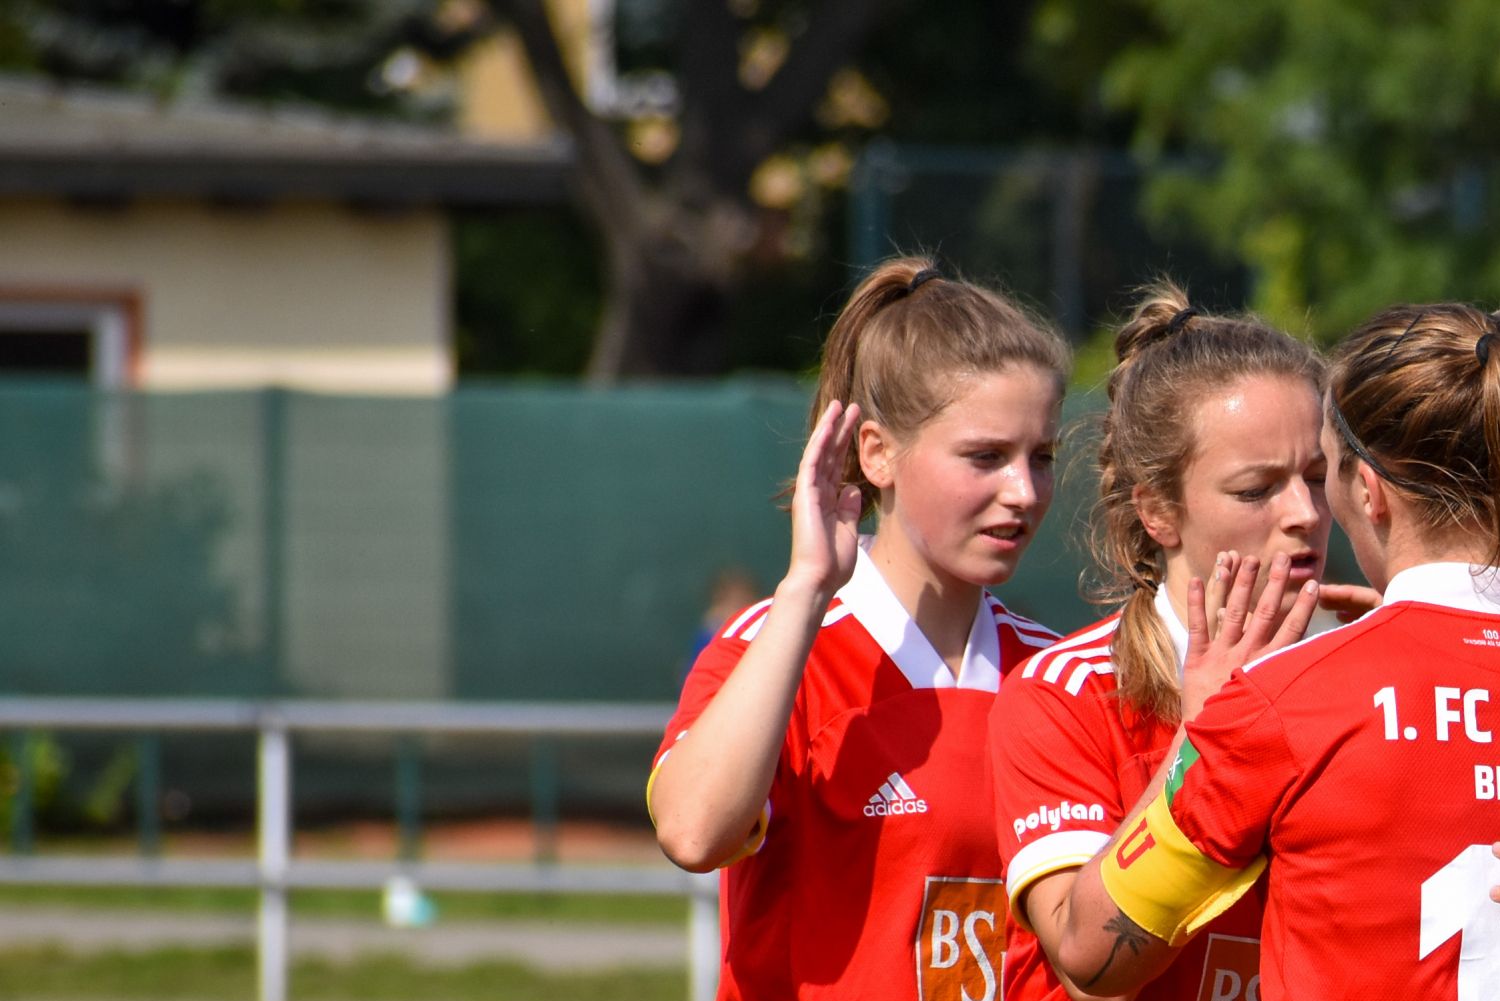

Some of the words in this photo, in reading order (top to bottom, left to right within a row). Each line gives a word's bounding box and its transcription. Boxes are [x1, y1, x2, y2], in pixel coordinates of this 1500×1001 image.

[1482, 629, 1499, 640] 100
[1373, 686, 1418, 742] 1.
[1434, 686, 1493, 744] FC
[863, 799, 928, 818] adidas
[1013, 801, 1105, 843] polytan
[1116, 817, 1156, 870] U
